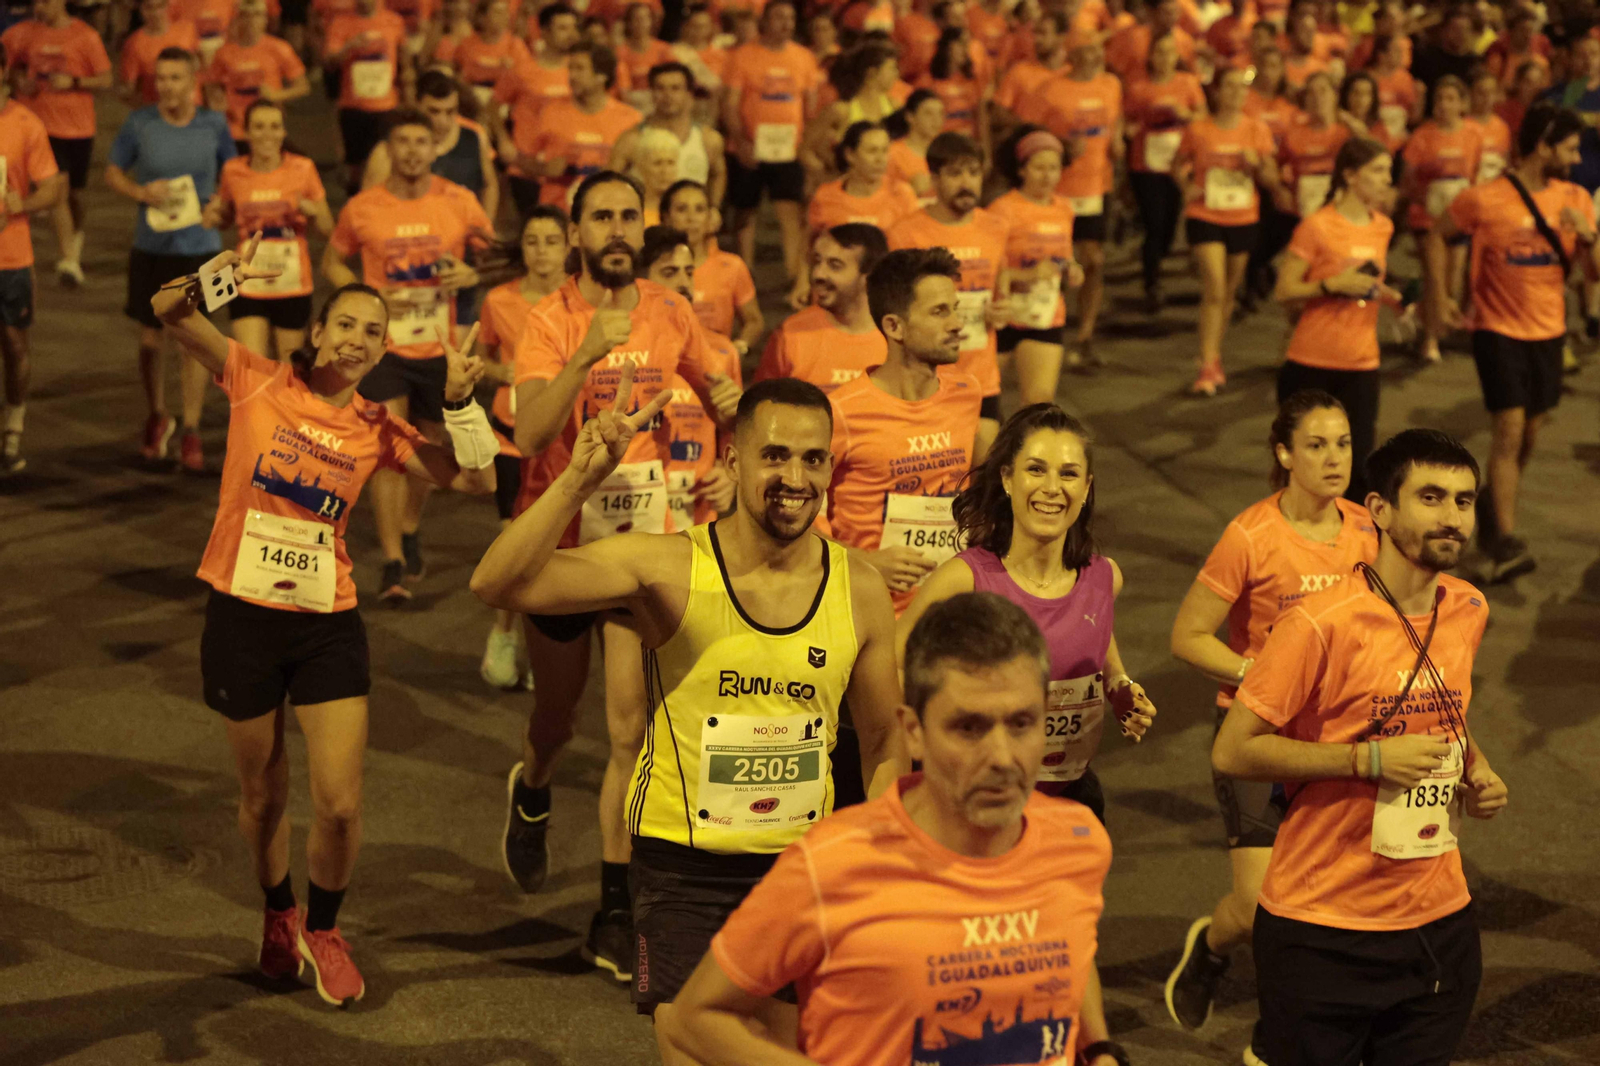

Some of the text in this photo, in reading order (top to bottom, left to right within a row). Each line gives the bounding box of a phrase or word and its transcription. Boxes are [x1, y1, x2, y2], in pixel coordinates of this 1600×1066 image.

[275, 424, 313, 446] CARRERA
[299, 421, 343, 452] XXXV
[907, 431, 951, 454] XXXV
[278, 435, 355, 472] GUADALQUIVIR
[889, 454, 927, 466] CARRERA
[601, 493, 653, 512] 14677
[903, 529, 955, 548] 18486
[260, 545, 319, 573] 14681
[718, 670, 816, 700] RUN & GO
[733, 756, 800, 782] 2505
[735, 784, 796, 795] RAUL SANCHEZ CASAS
[960, 909, 1040, 947] XXXV
[638, 933, 649, 992] ADIZERO
[926, 939, 1069, 968] CARRERA NOCTURNA
[939, 953, 1071, 984] GUADALQUIVIR
